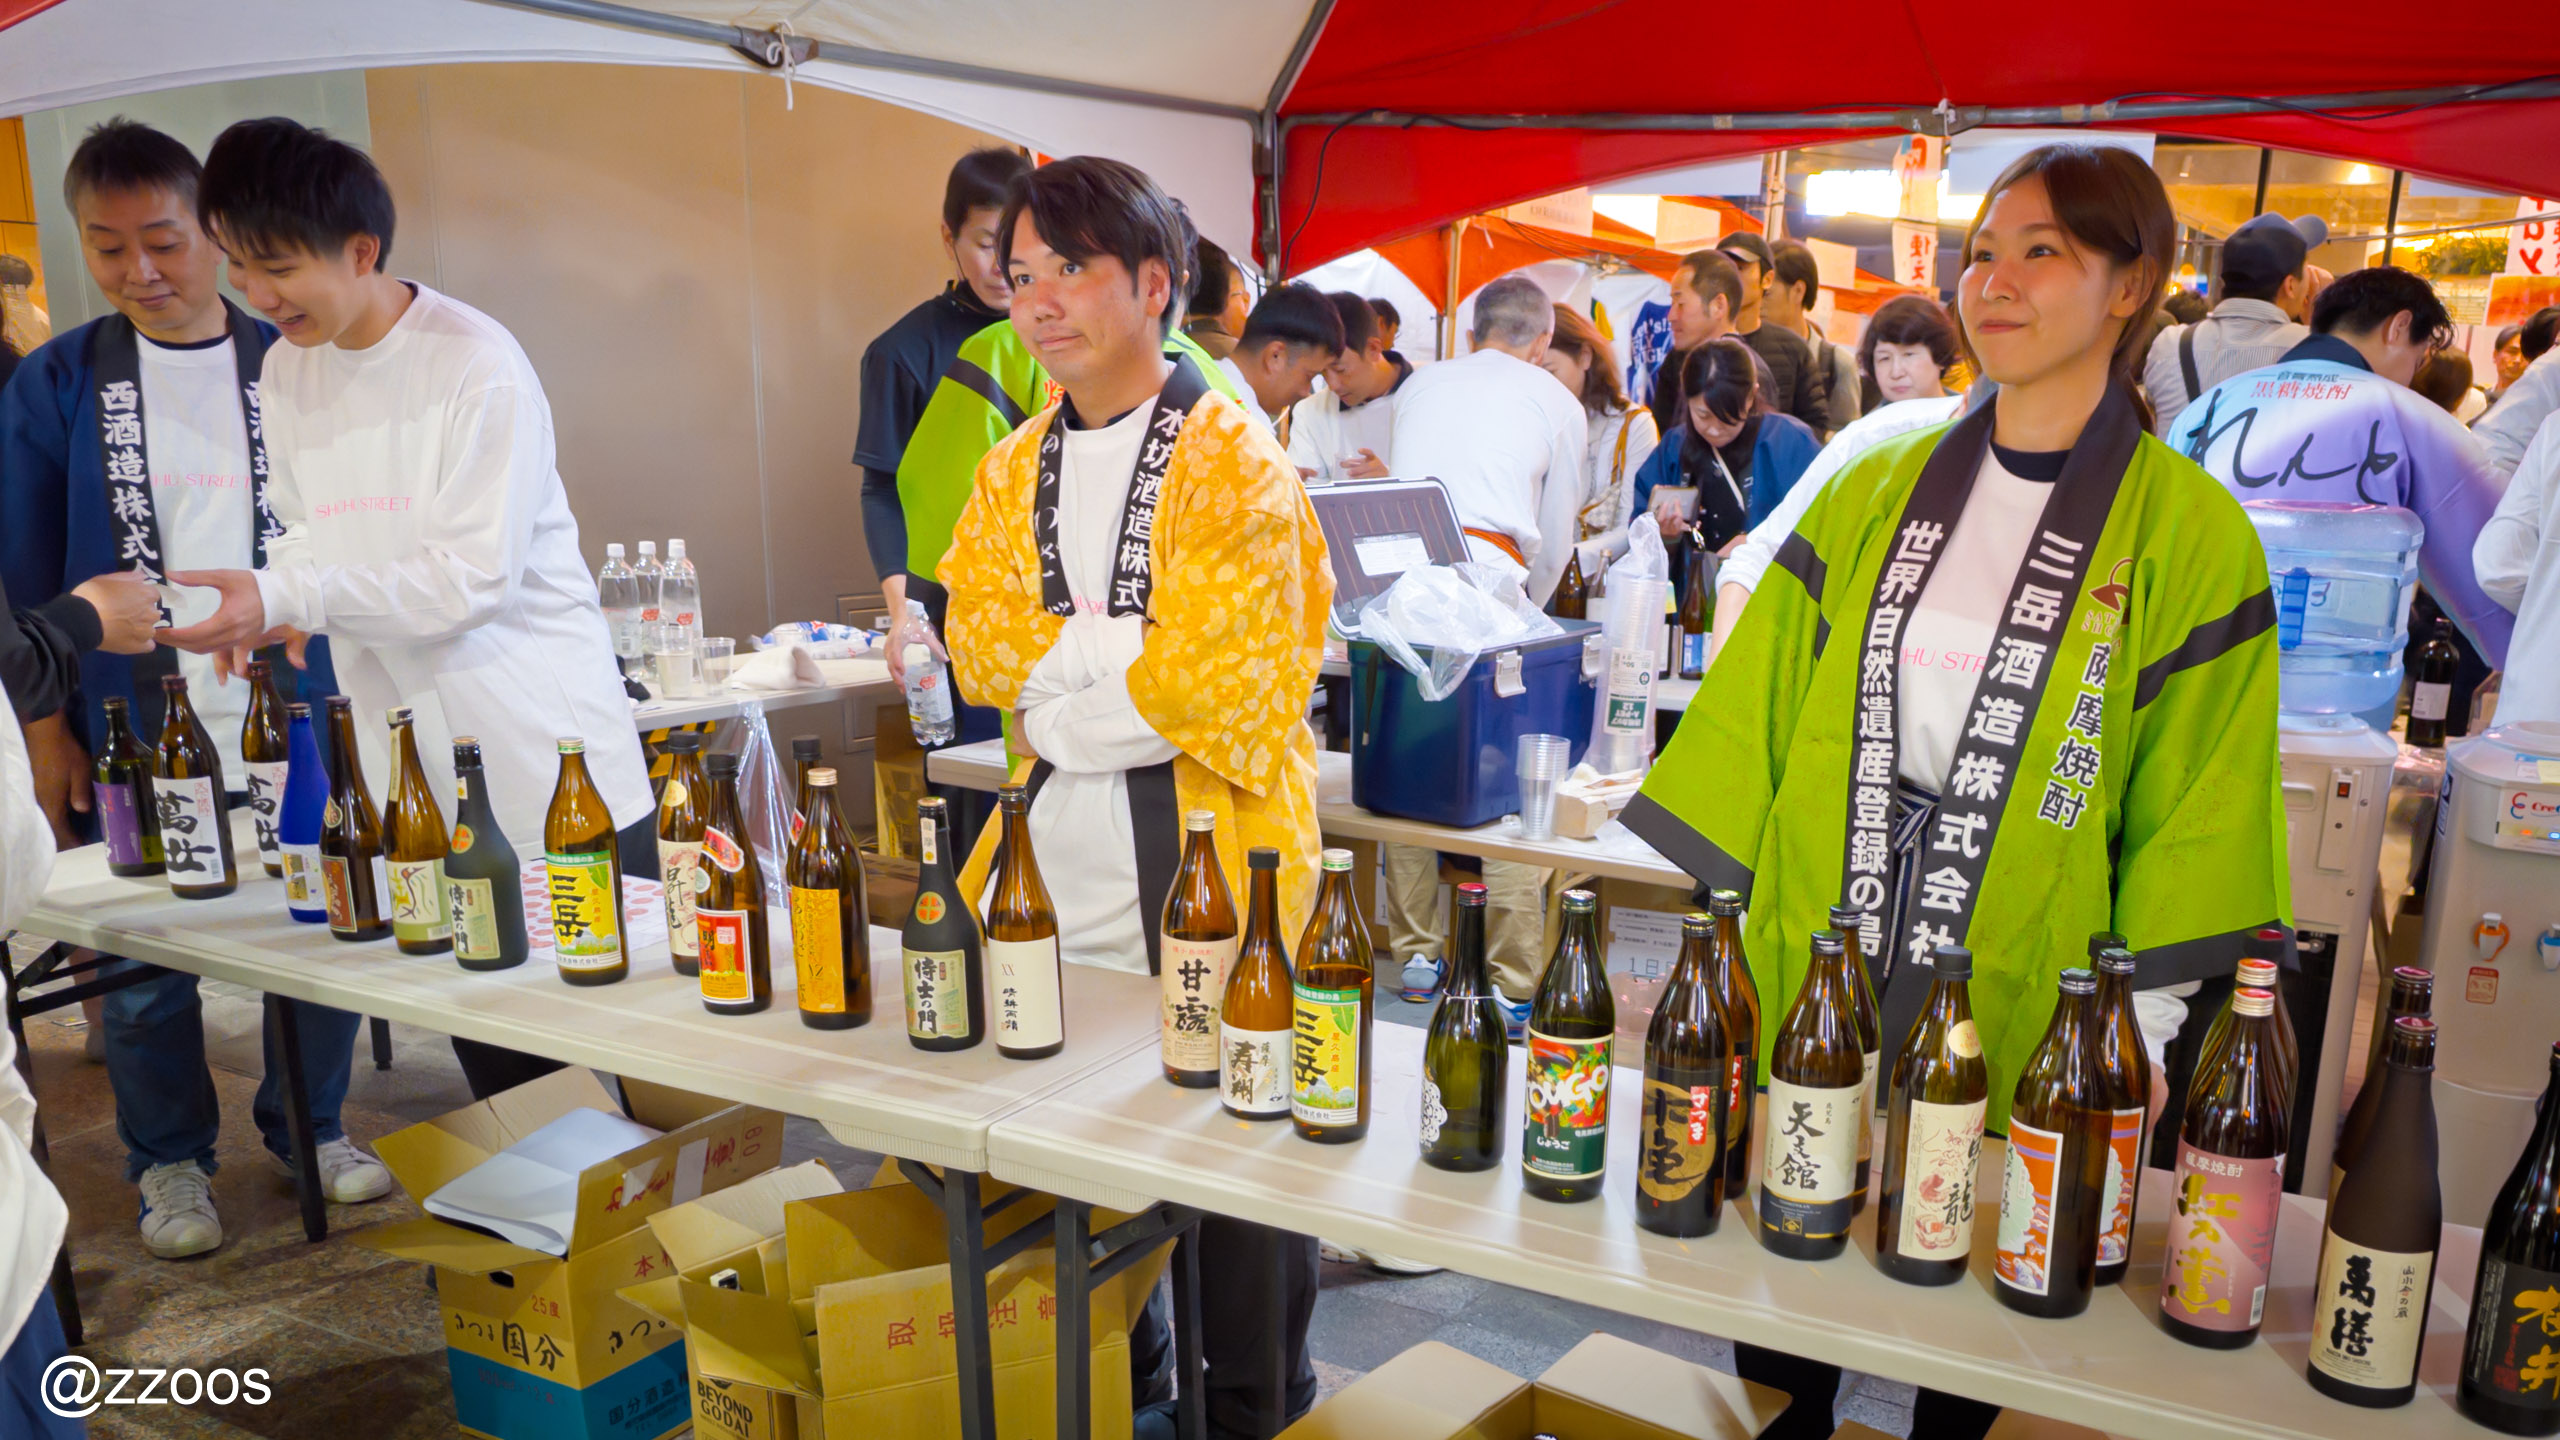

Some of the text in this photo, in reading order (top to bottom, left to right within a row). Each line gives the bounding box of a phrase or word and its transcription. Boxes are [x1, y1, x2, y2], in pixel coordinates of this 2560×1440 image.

[100, 380, 171, 627] 西酒造株式会
[360, 497, 412, 513] STREET
[1115, 407, 1187, 617] 本坊酒造株式
[2085, 610, 2119, 625] SAT
[1849, 520, 1943, 957] 世界自然遺産登録の島
[1909, 530, 2083, 967] 三岳酒造株式会社
[551, 874, 592, 938] 三岳
[1176, 958, 1212, 1034] 甘露
[1293, 1007, 1329, 1086] 三岳
[1690, 1092, 1709, 1141] さつま
[532, 1295, 561, 1319] 25度
[696, 1379, 753, 1425] BEYOND
[701, 1398, 749, 1438] GODAI
